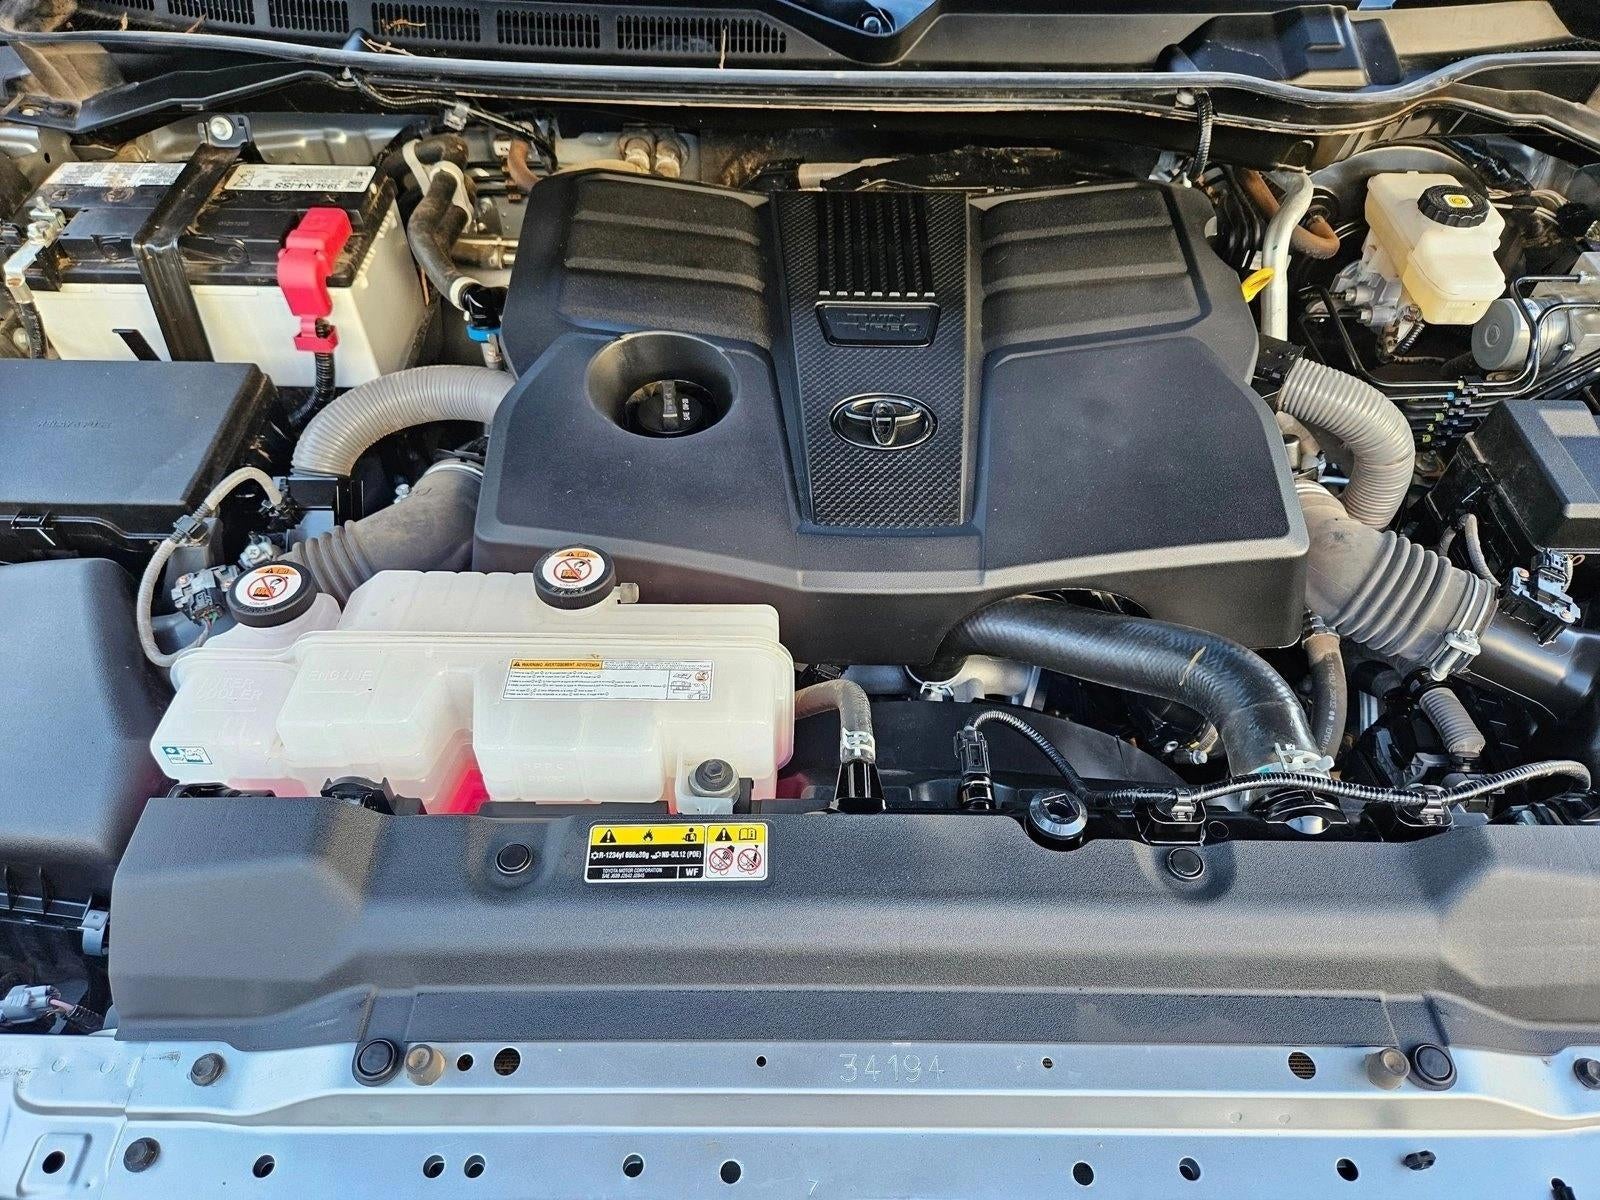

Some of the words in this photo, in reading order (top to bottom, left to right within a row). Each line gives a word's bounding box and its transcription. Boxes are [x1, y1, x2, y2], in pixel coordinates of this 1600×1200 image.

[682, 411, 691, 421] SAE
[309, 670, 374, 681] ENGINE
[599, 851, 624, 860] R-1234yf
[686, 850, 702, 860] (POE)
[685, 867, 699, 877] WF
[839, 1053, 945, 1083] 34194
